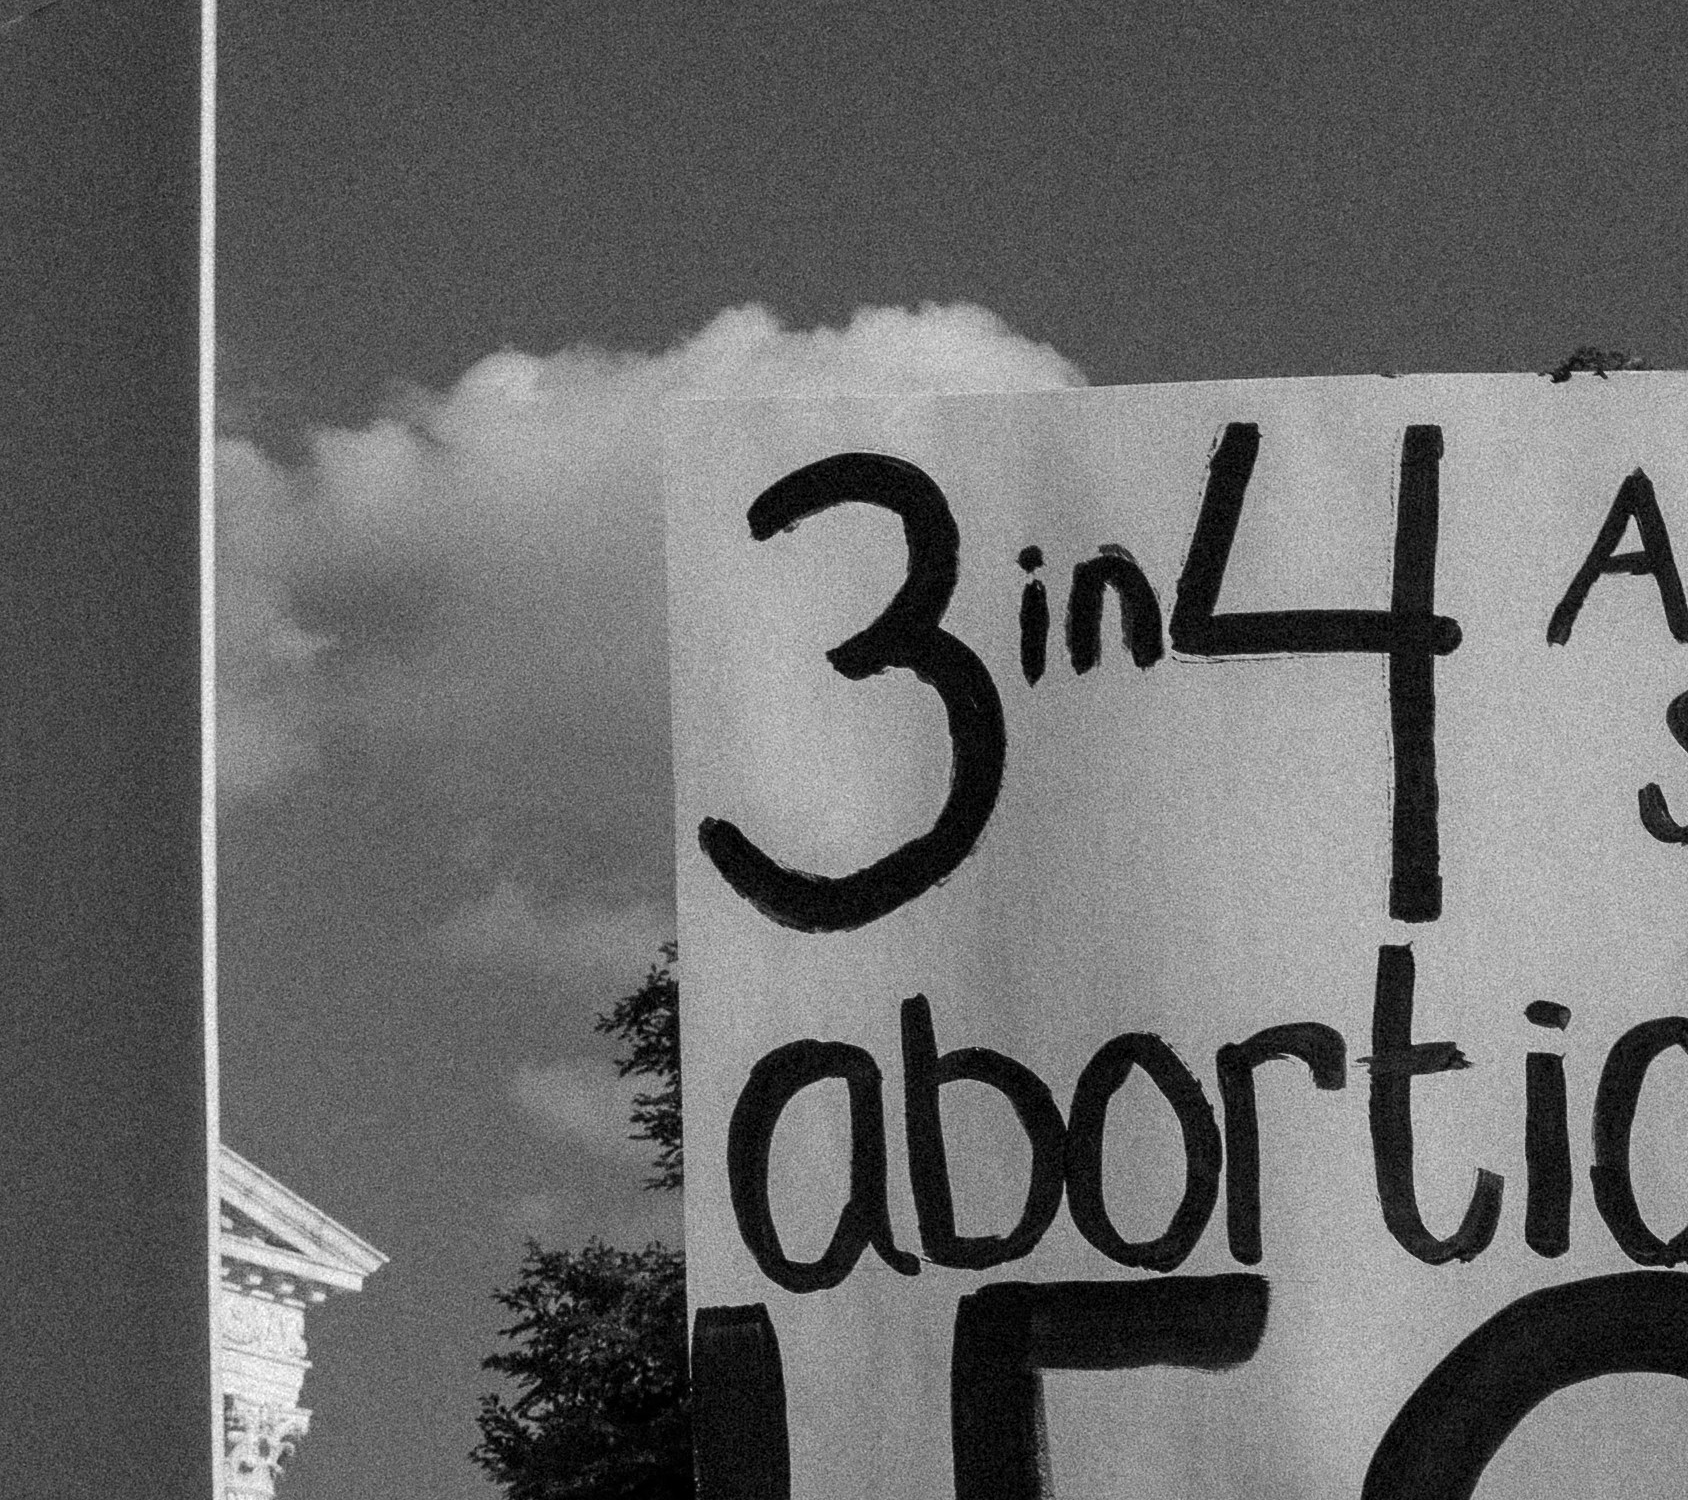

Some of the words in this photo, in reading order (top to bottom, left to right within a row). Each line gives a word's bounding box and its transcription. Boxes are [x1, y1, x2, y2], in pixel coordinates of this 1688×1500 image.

[697, 451, 1006, 932] 3
[1017, 544, 1162, 686] in
[1171, 422, 1463, 924] 4
